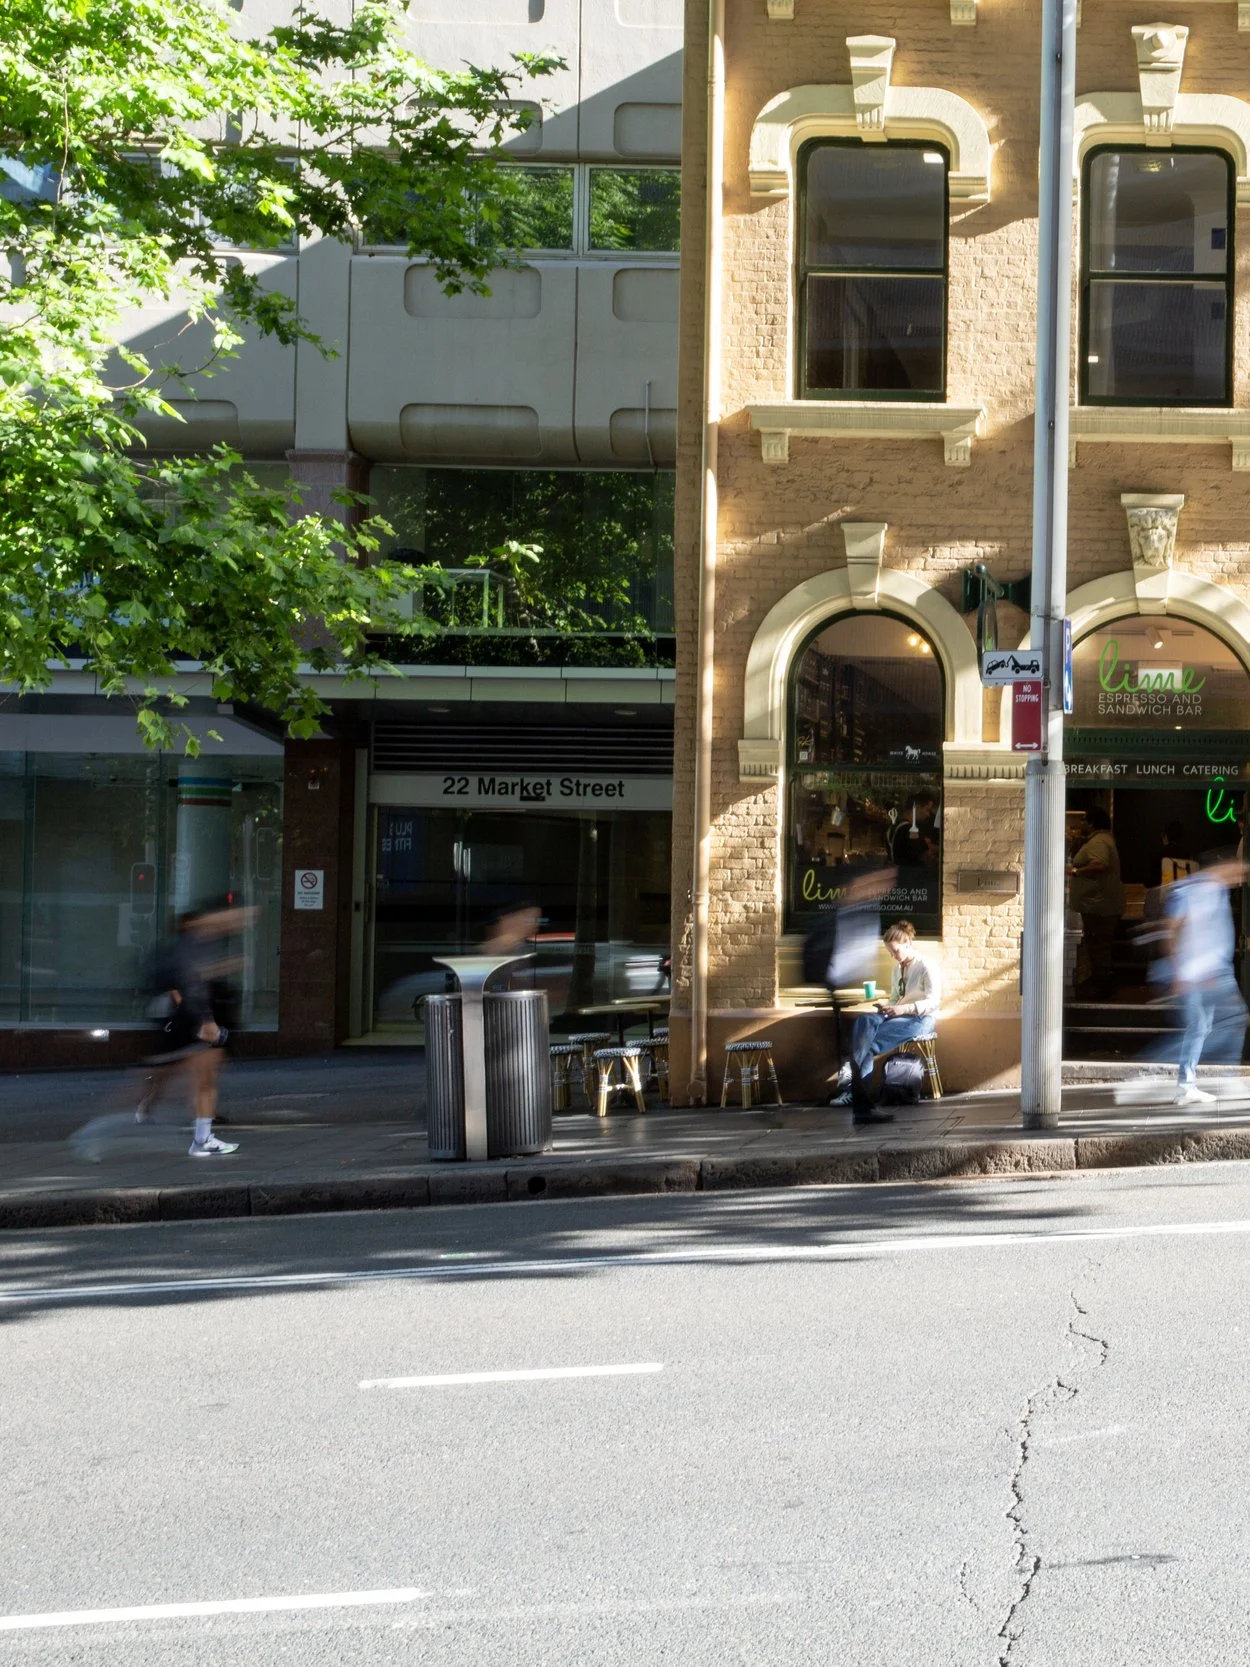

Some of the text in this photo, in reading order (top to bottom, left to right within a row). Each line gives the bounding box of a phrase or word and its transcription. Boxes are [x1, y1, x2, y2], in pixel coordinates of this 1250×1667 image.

[1098, 639, 1206, 694] lime
[1022, 684, 1032, 693] NO
[1015, 694, 1039, 703] STOPPING
[1098, 693, 1202, 705] ESPRESSO AND
[1098, 704, 1202, 716] SANDWICH BAR
[1136, 764, 1175, 775] LUNCH
[1183, 765, 1239, 776] CATERING
[442, 776, 625, 798] 22 Market Street
[909, 887, 928, 895] AND
